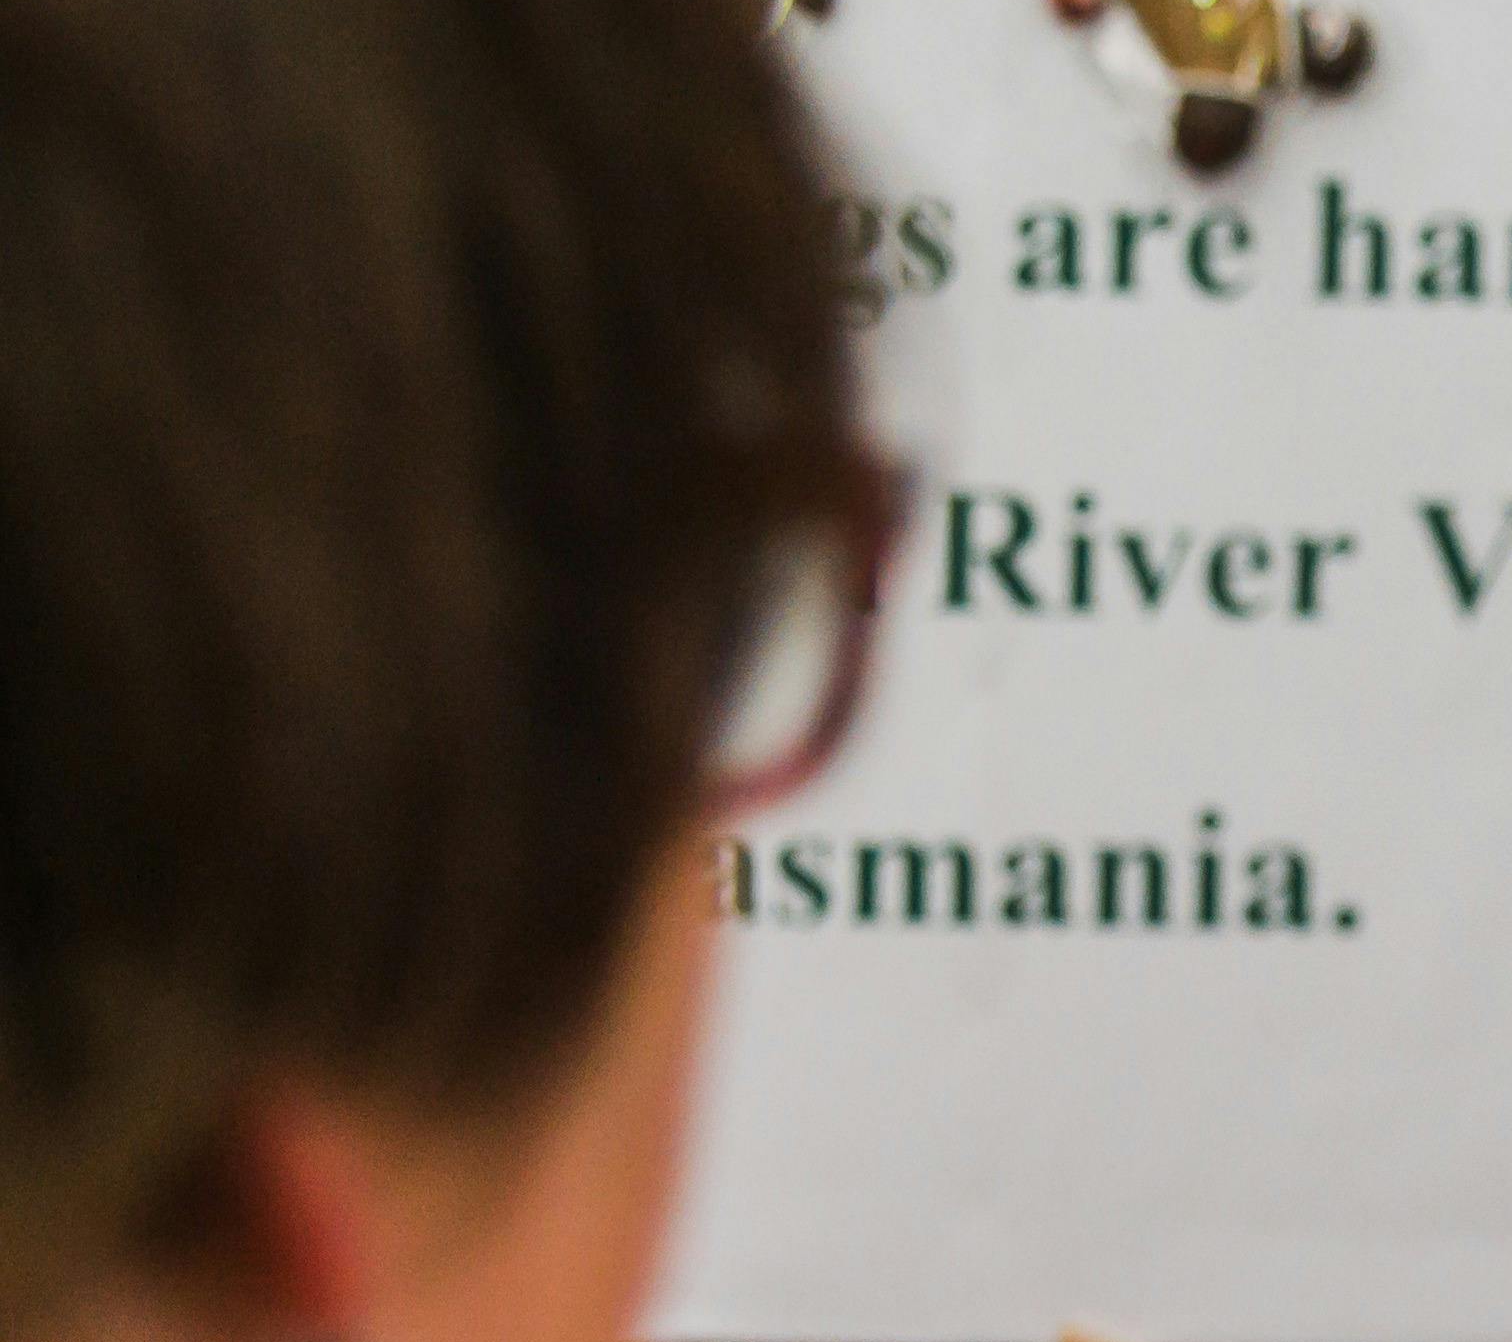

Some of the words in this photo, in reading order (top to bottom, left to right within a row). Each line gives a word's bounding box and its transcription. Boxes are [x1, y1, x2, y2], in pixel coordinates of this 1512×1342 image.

[1013, 196, 1254, 299] are
[942, 490, 1354, 619] River
[717, 811, 1360, 933] asmania.
